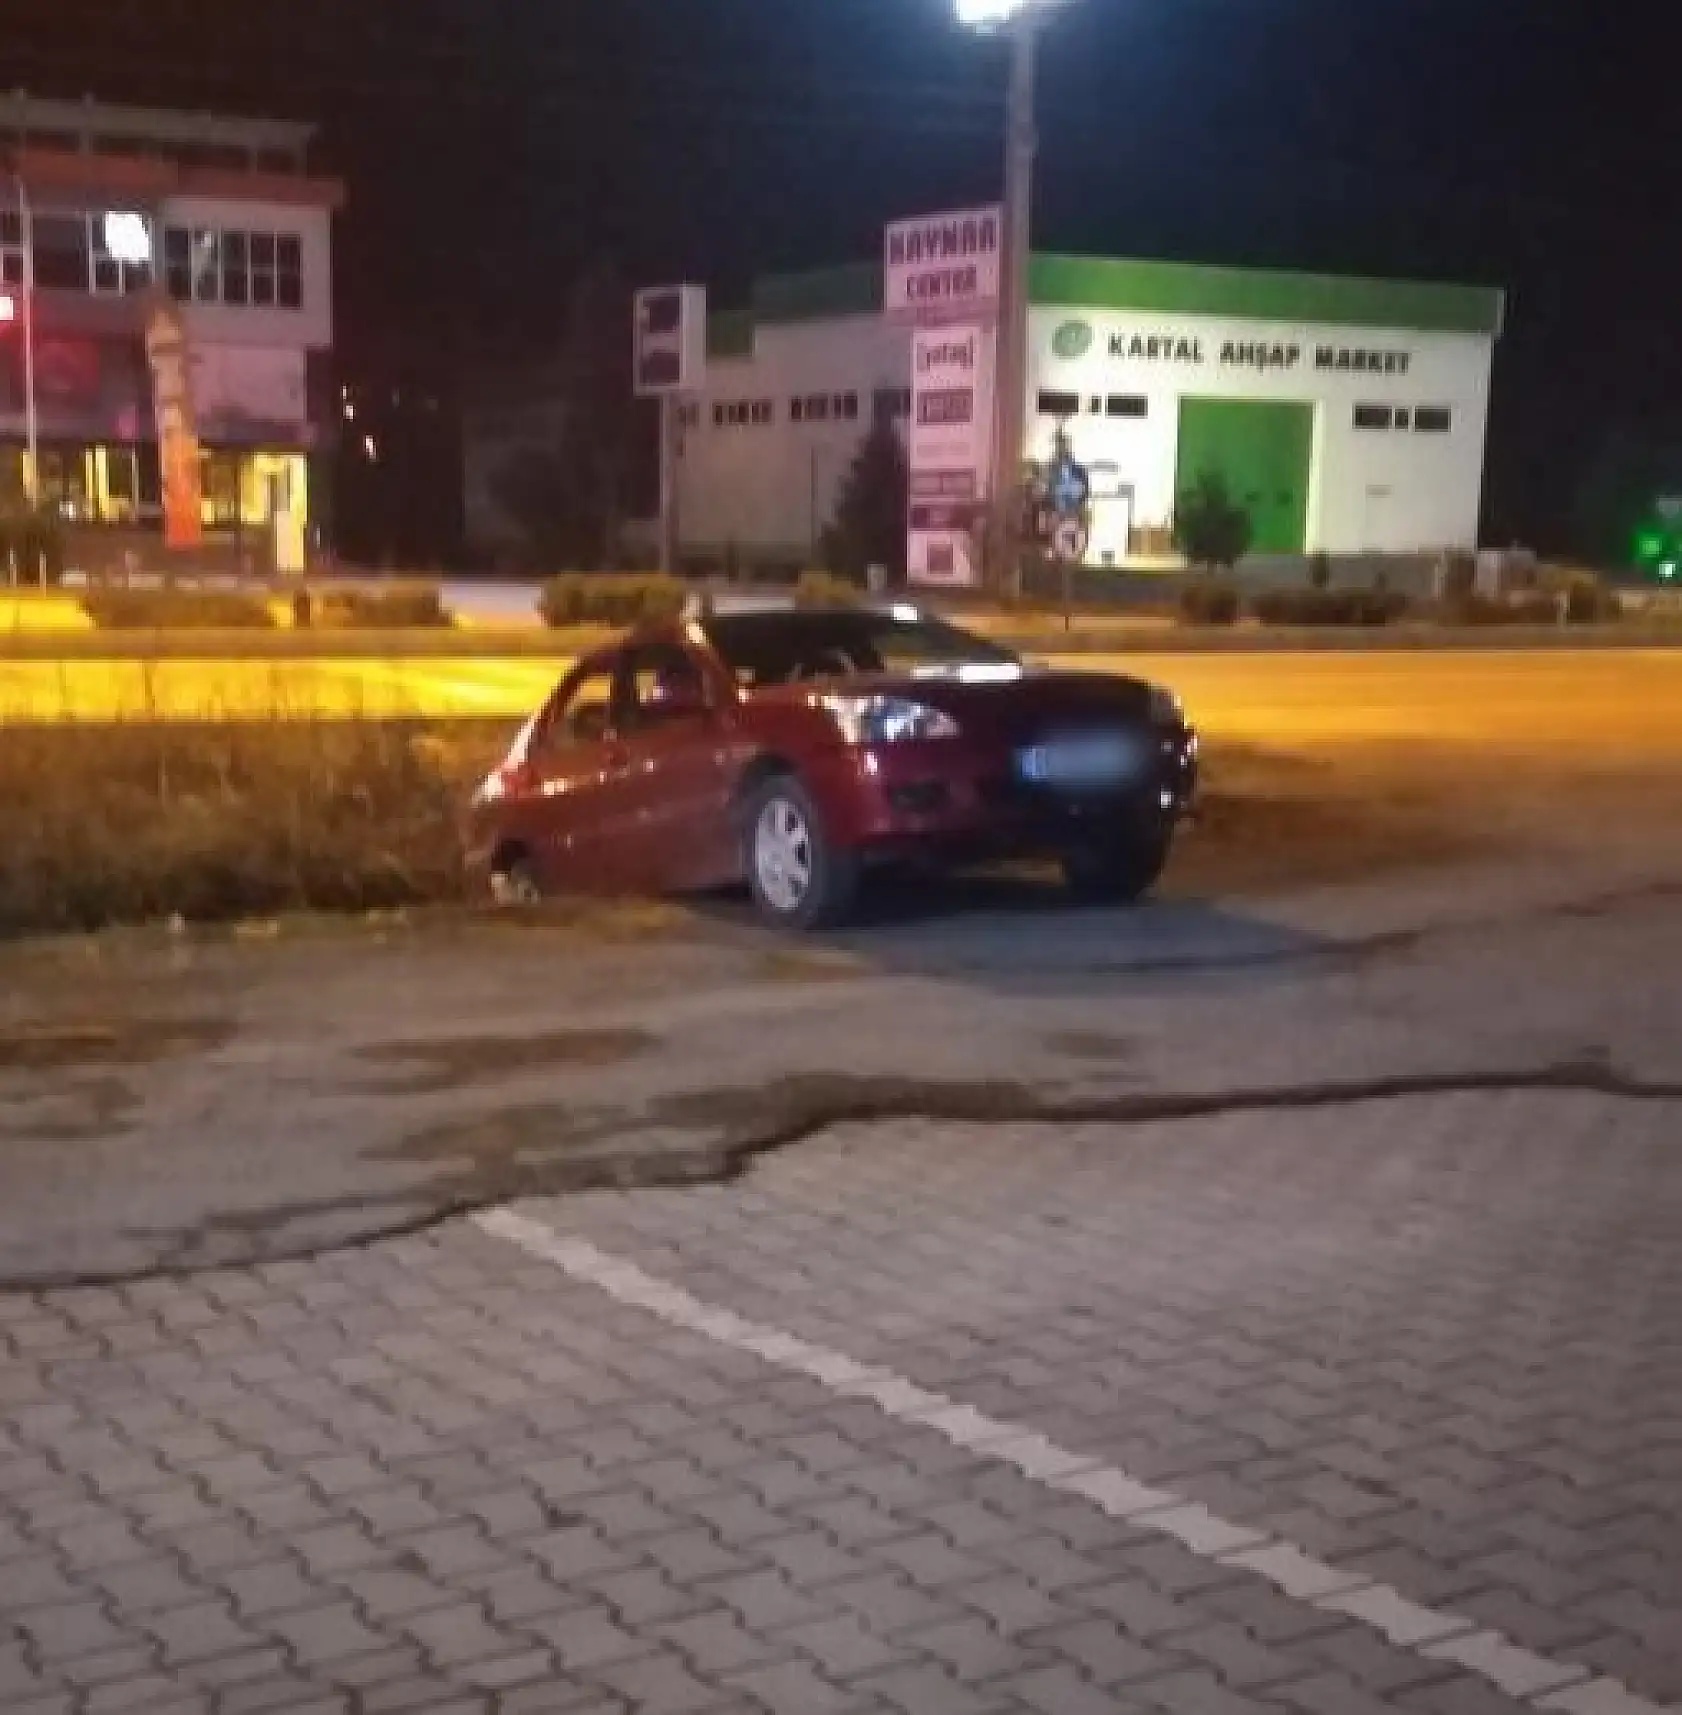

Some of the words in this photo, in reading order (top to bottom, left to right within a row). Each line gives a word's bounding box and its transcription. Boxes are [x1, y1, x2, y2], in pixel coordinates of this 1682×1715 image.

[1108, 332, 1205, 364] KARTAL
[1219, 341, 1302, 374] AHŞAP
[1314, 344, 1412, 374] MARKET
